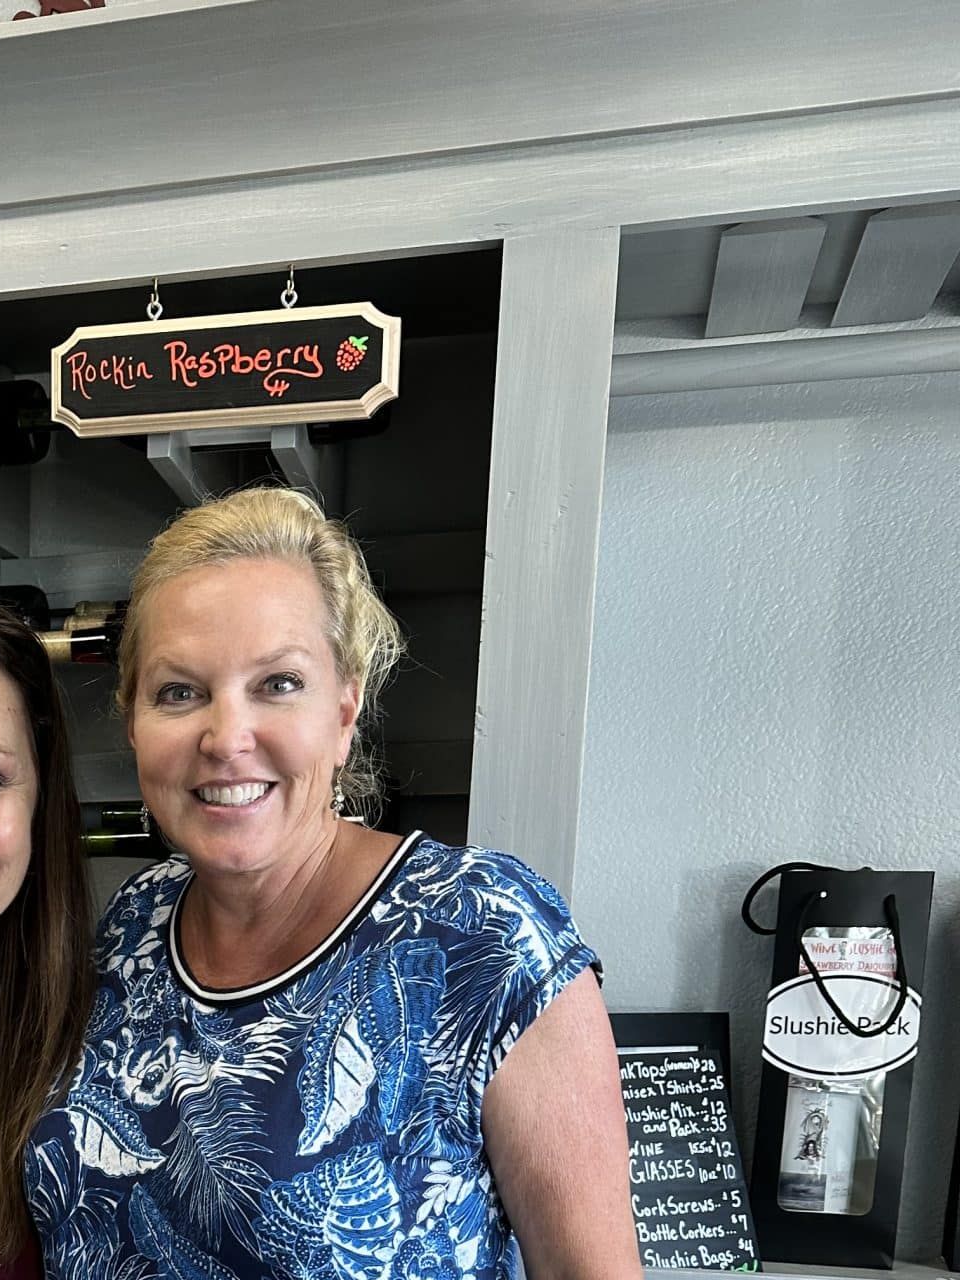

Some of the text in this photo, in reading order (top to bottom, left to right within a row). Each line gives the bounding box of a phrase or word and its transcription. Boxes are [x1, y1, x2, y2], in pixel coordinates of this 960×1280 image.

[66, 351, 154, 399] Rockin
[622, 1085, 657, 1100] nisex
[642, 1121, 667, 1134] and
[635, 1221, 679, 1243] Bottle
[644, 1248, 699, 1269] Slushie
